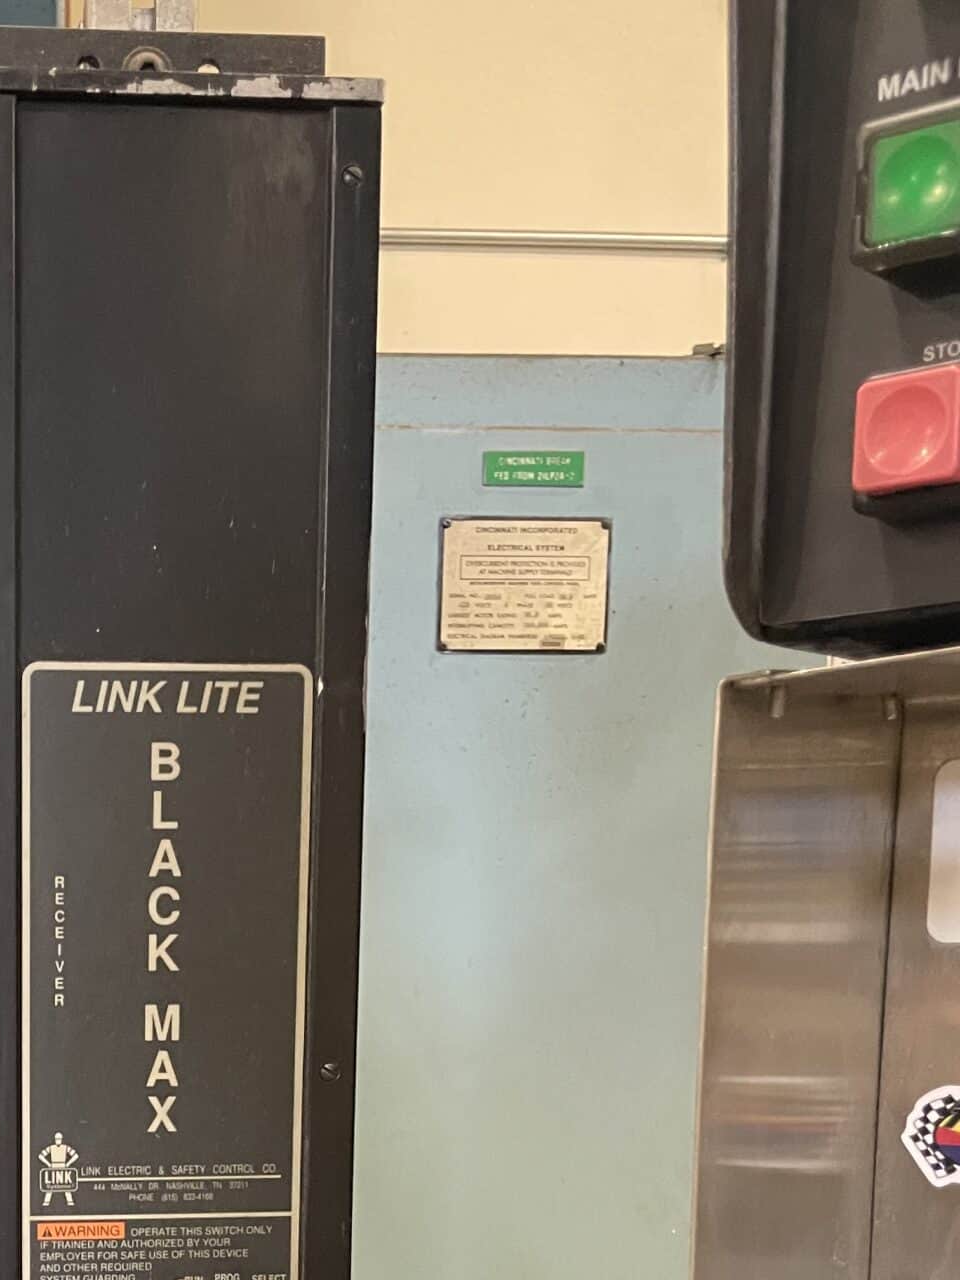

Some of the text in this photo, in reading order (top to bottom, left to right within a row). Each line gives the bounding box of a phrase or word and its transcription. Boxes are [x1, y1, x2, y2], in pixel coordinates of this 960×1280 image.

[878, 57, 950, 102] MAIN
[71, 680, 263, 714] LINK LITE
[147, 741, 182, 972] BLACK
[54, 876, 65, 1007] RECEIVER
[143, 1004, 181, 1133] MAX
[44, 1170, 72, 1184] LINK
[81, 1164, 255, 1177] LINK ELECTRIC SAFETY CONTROL
[55, 1225, 272, 1237] WARNING OPERATE THIS SWITCH ONLY
[40, 1238, 230, 1249] IF TRAINED AND AUTHORIZED BY YOUR
[40, 1249, 248, 1261] EMPLOYER FOR SAFE USE OF THIS DEVICE
[40, 1262, 152, 1272] AND OTHER REQUIRED
